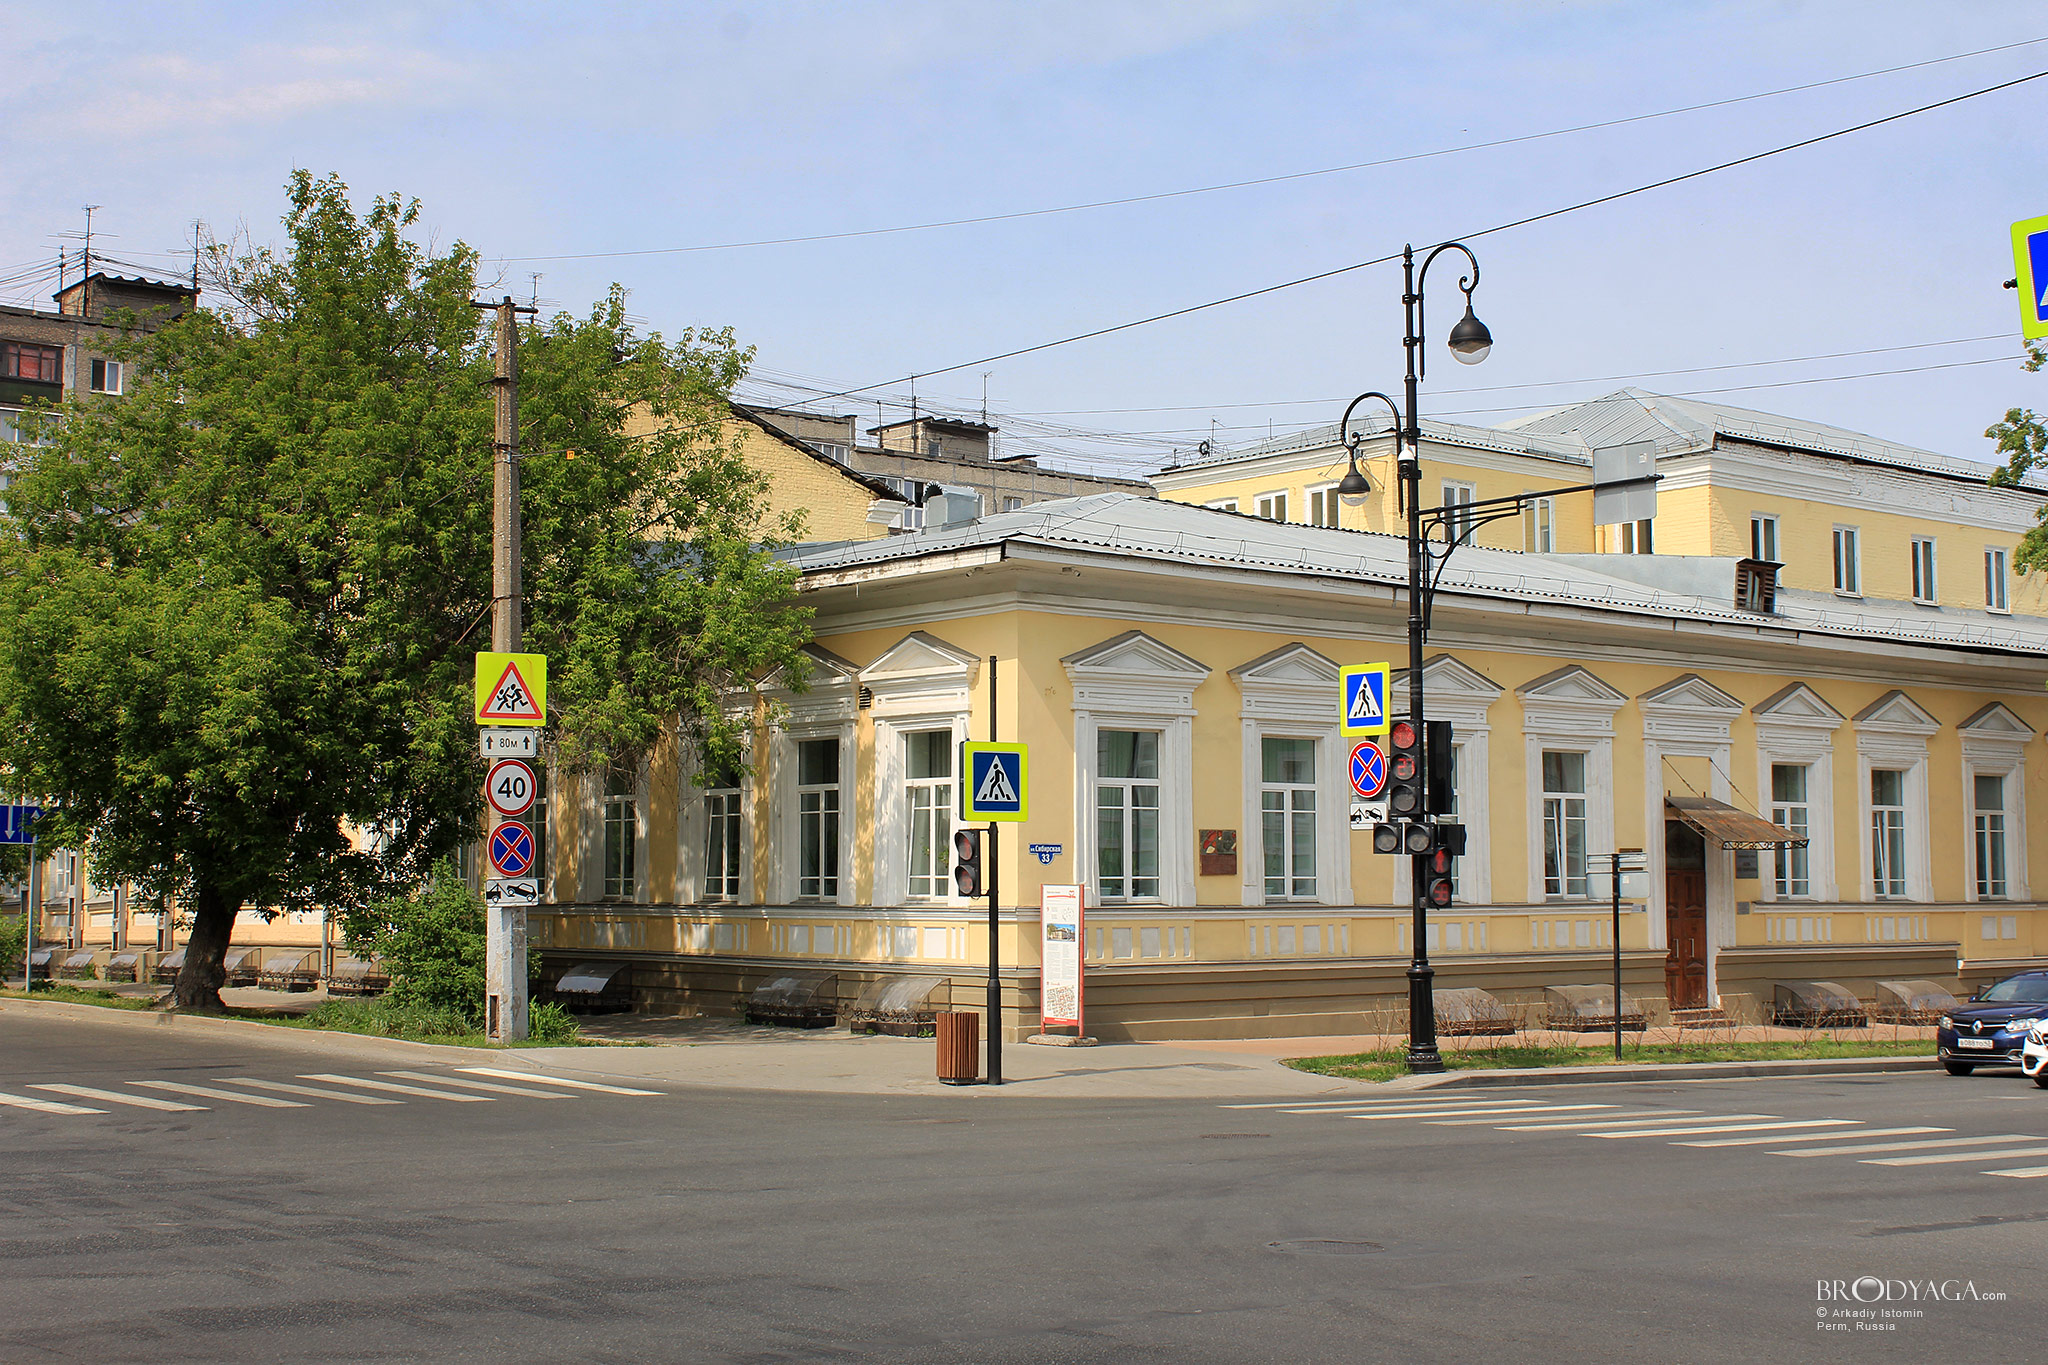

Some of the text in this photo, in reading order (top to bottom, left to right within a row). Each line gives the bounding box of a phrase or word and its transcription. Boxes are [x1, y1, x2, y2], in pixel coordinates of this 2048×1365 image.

[499, 738, 518, 748] 80м
[497, 776, 526, 798] 40
[1041, 853, 1050, 863] 33
